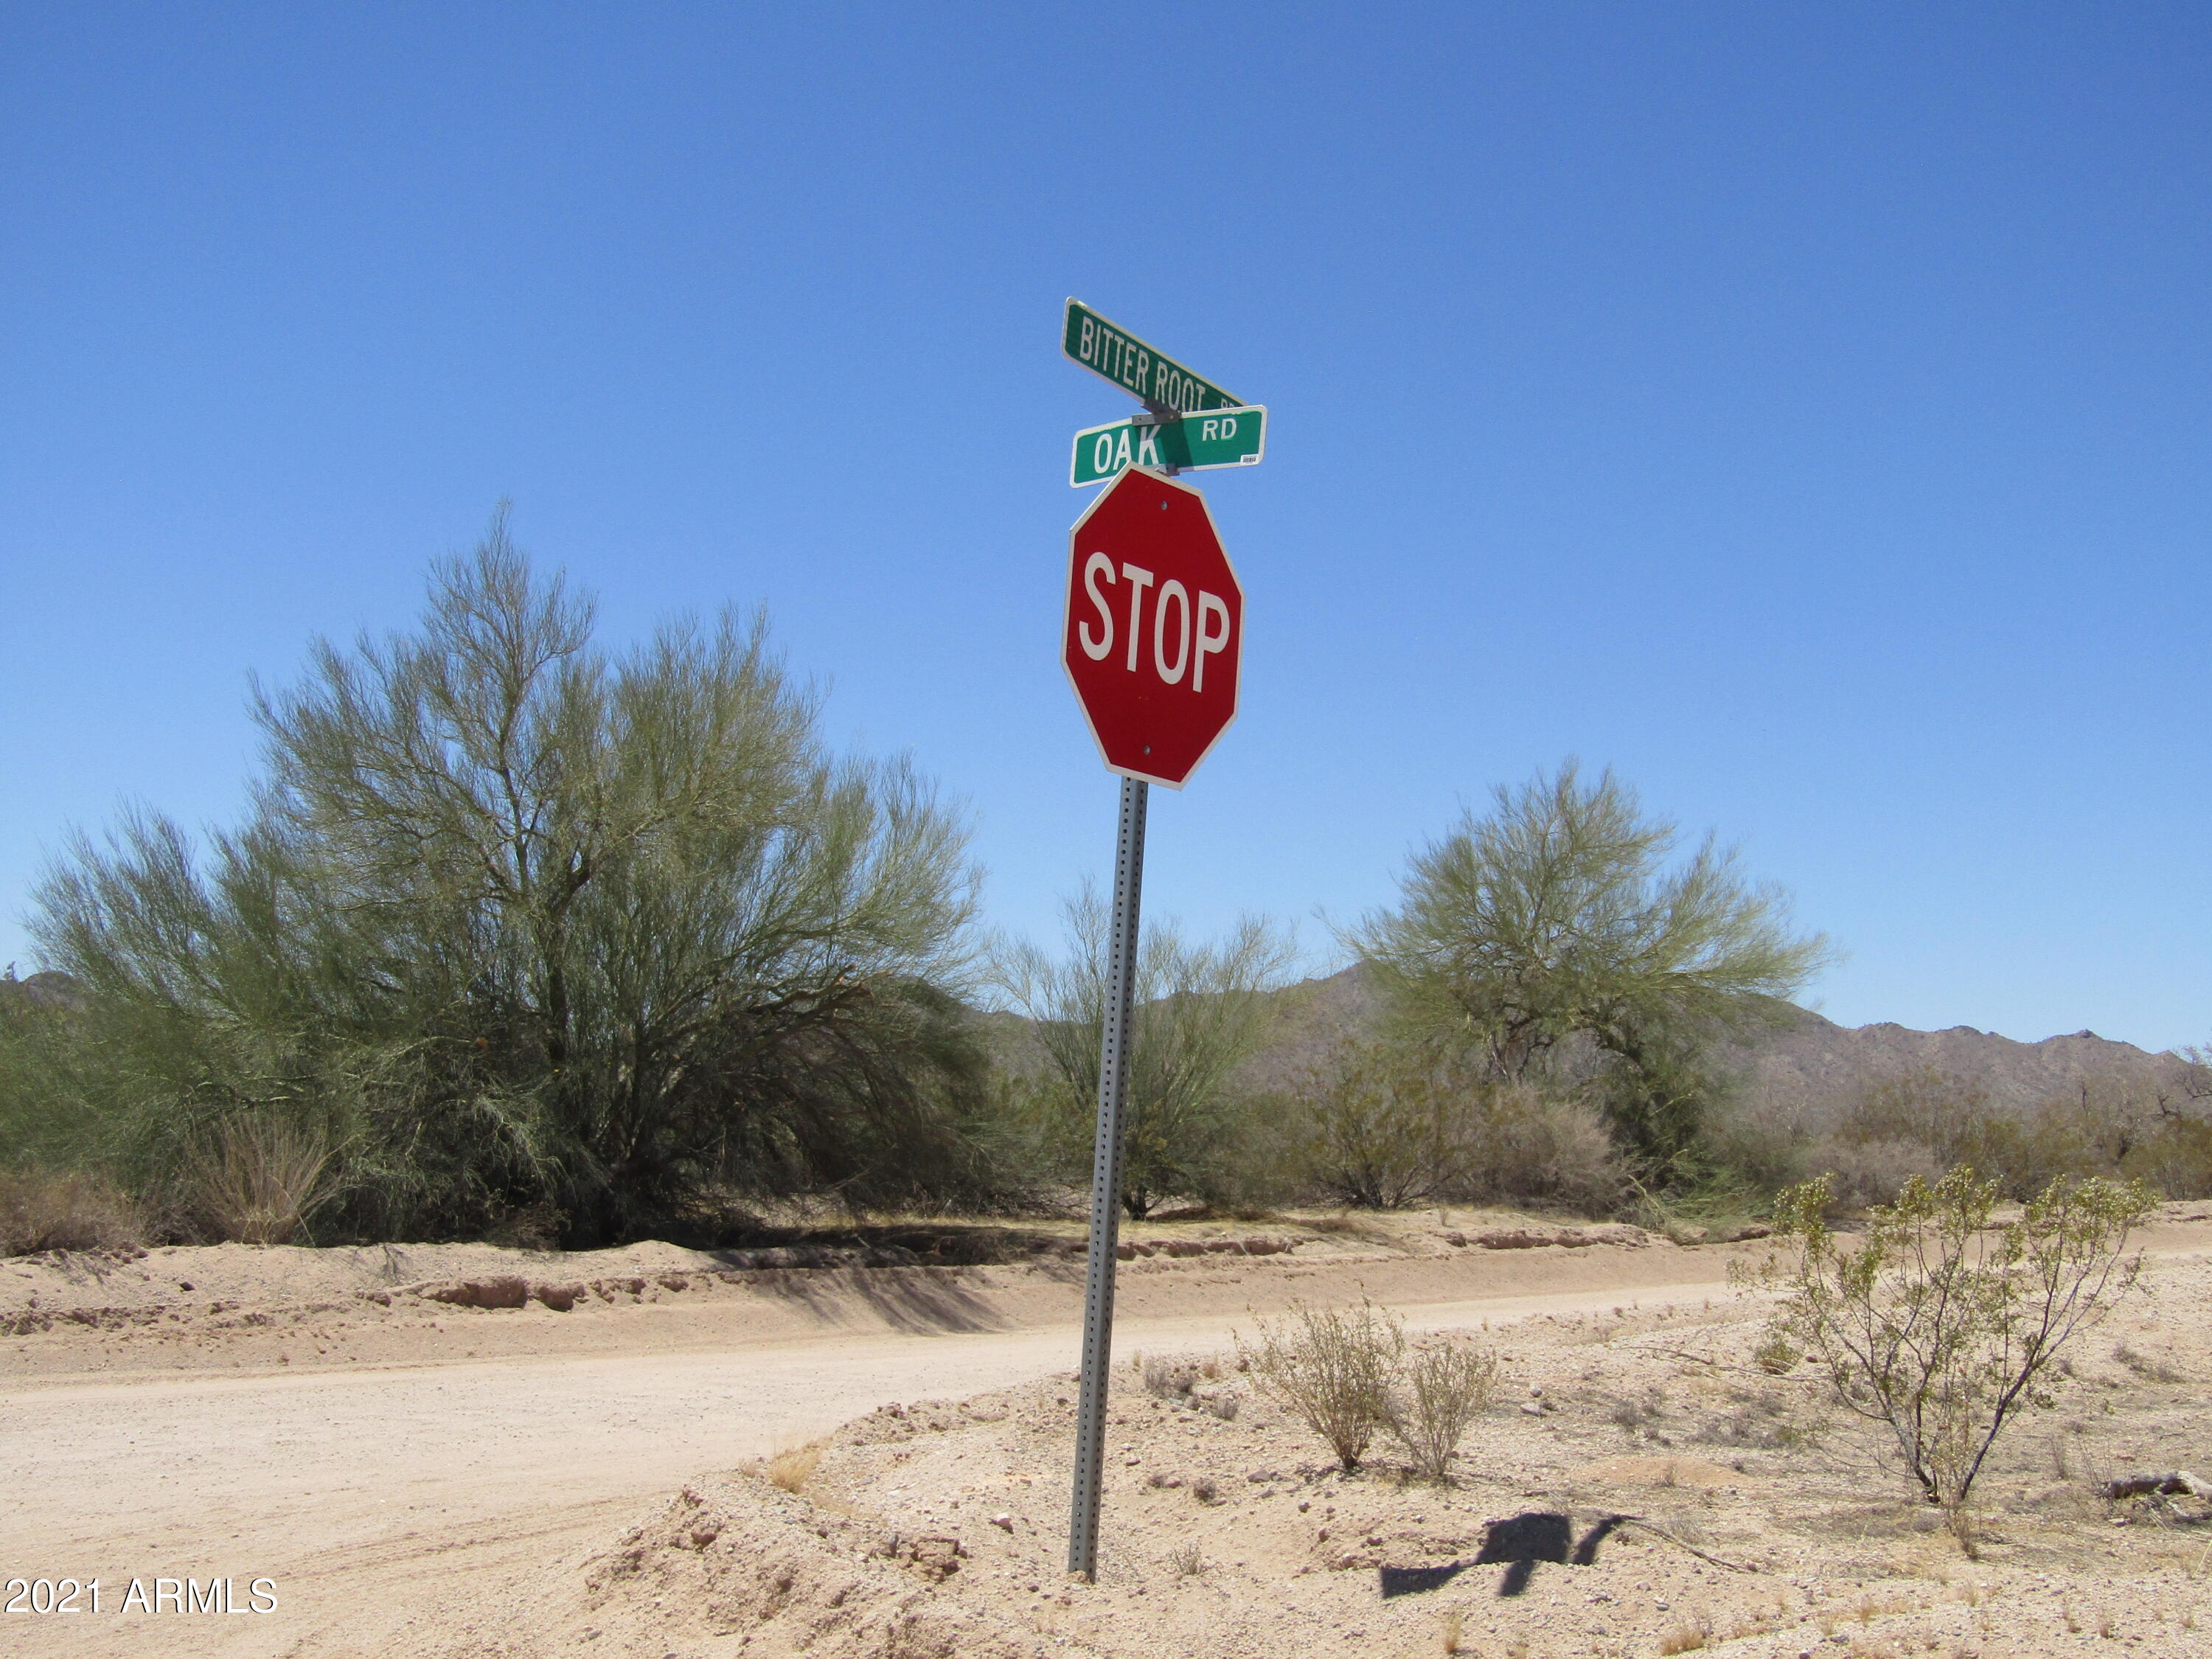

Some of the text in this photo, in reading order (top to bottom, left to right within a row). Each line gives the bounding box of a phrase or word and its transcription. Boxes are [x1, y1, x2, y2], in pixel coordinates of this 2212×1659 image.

[1079, 316, 1149, 394] BITTER
[1155, 361, 1206, 412] ROOT
[1093, 418, 1237, 473] OAK RD
[1079, 552, 1230, 692] STOP
